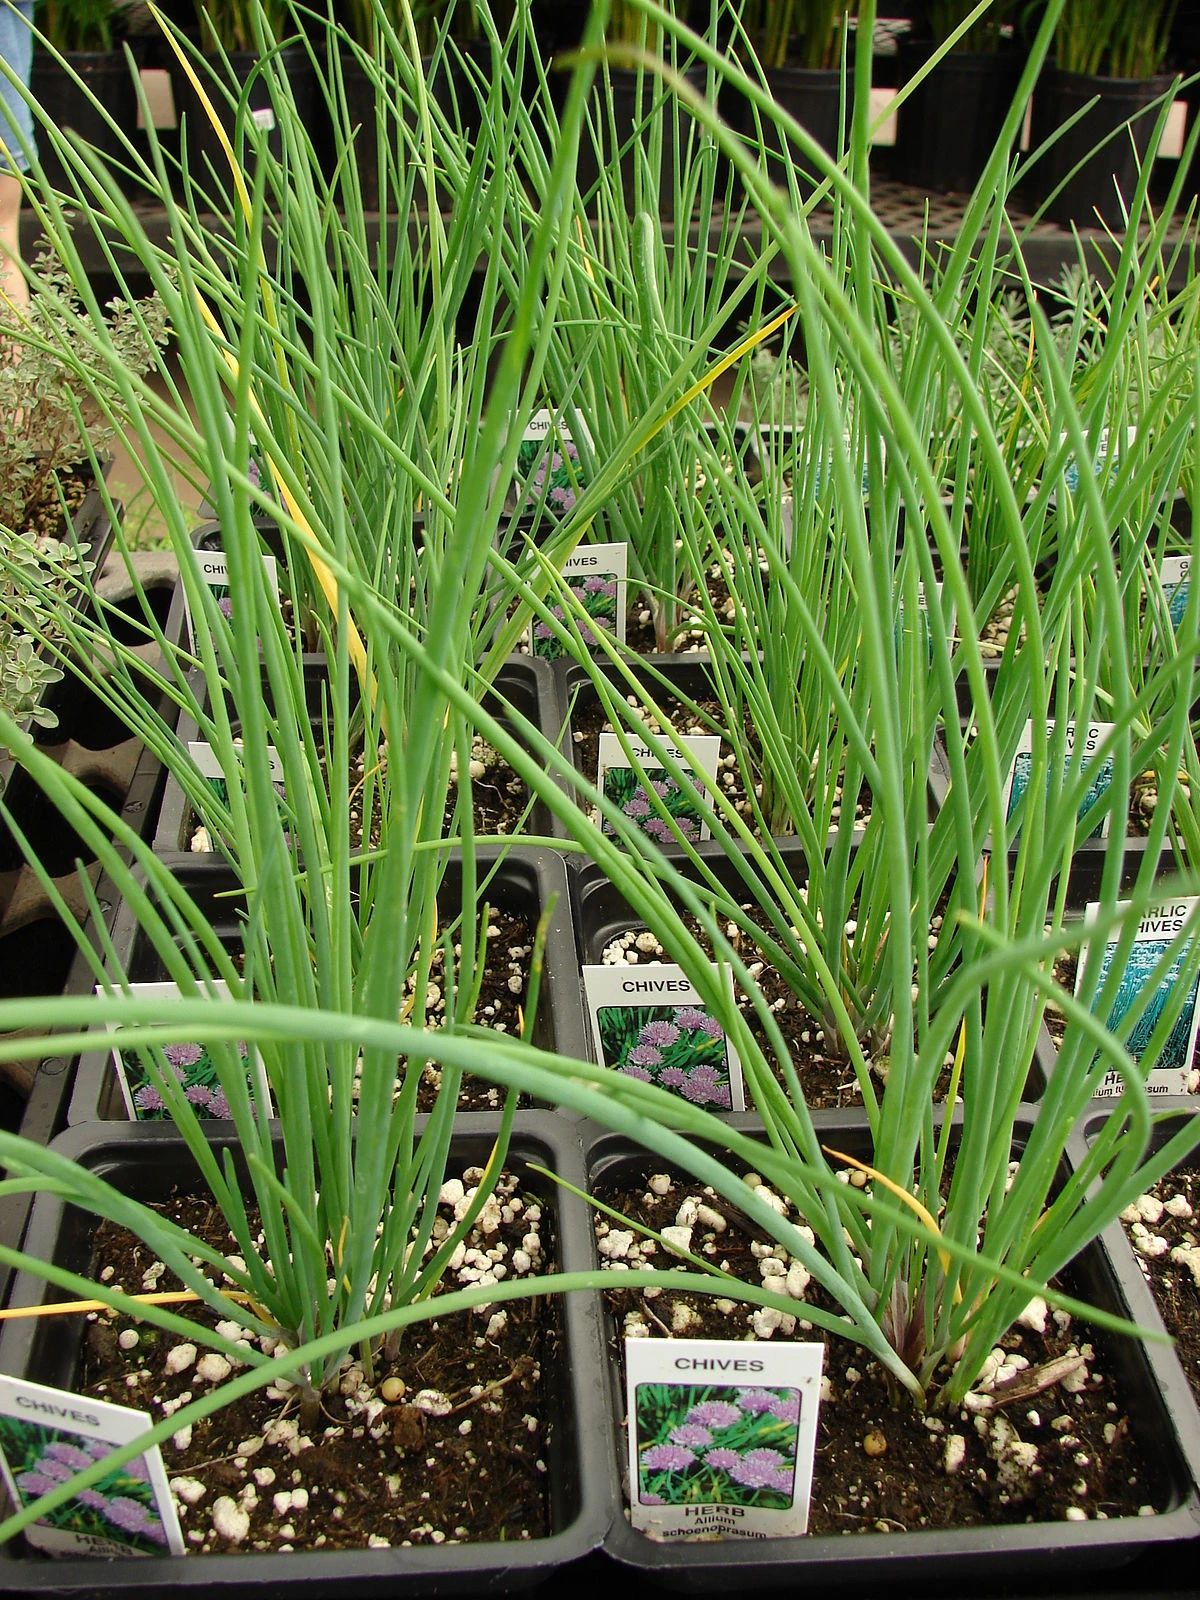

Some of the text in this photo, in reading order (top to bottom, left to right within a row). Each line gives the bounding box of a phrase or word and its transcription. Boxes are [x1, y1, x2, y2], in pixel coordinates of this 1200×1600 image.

[529, 421, 568, 431] CHIS
[565, 556, 598, 567] IVES
[203, 564, 228, 575] CHI
[632, 747, 684, 759] CHES
[1142, 904, 1187, 919] RLIC
[1138, 919, 1183, 933] HIVES
[622, 980, 691, 993] CHIVES
[674, 1357, 764, 1372] CHIVES
[16, 1396, 100, 1426] CHIVES
[684, 1505, 746, 1517] HERB
[694, 1515, 736, 1526] Allium
[662, 1524, 767, 1540] schoenoprasum
